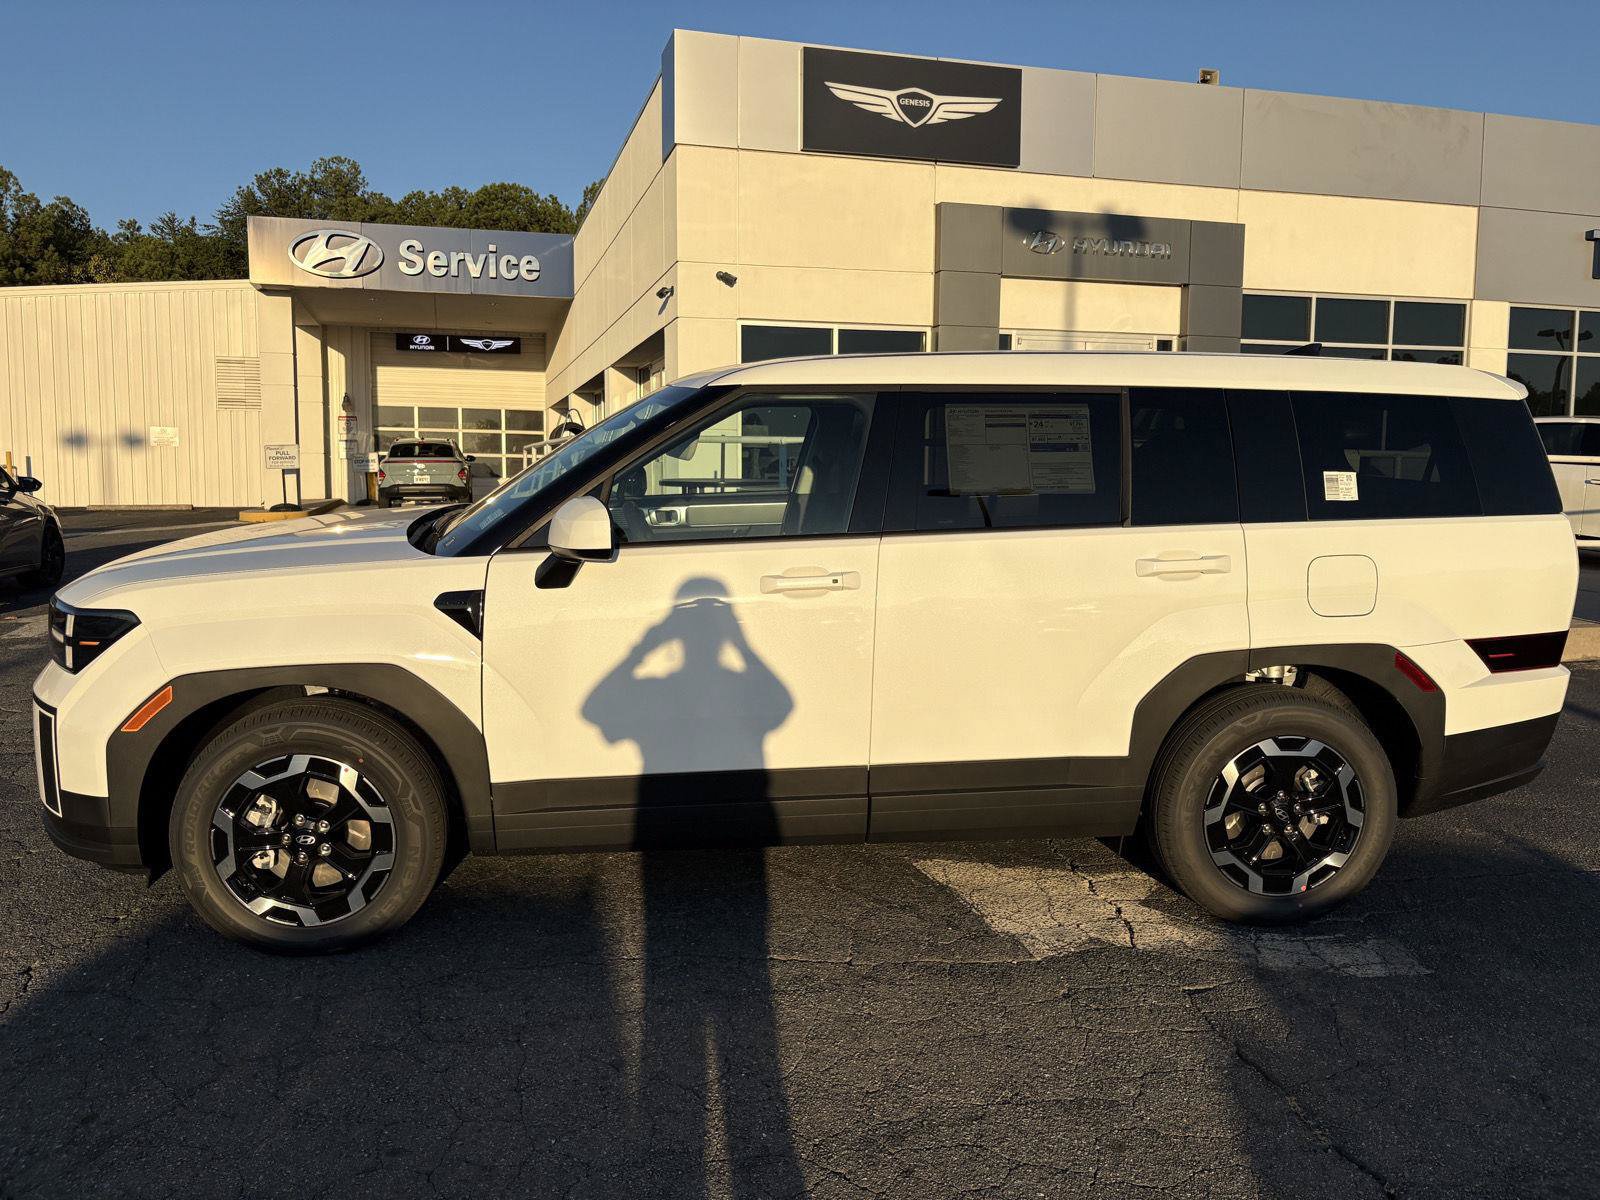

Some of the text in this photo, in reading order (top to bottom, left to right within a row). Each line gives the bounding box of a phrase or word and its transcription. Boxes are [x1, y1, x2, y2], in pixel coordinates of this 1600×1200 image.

[900, 98, 931, 107] GENESIS
[398, 239, 541, 281] Service
[1073, 238, 1171, 260] HYUNDAI
